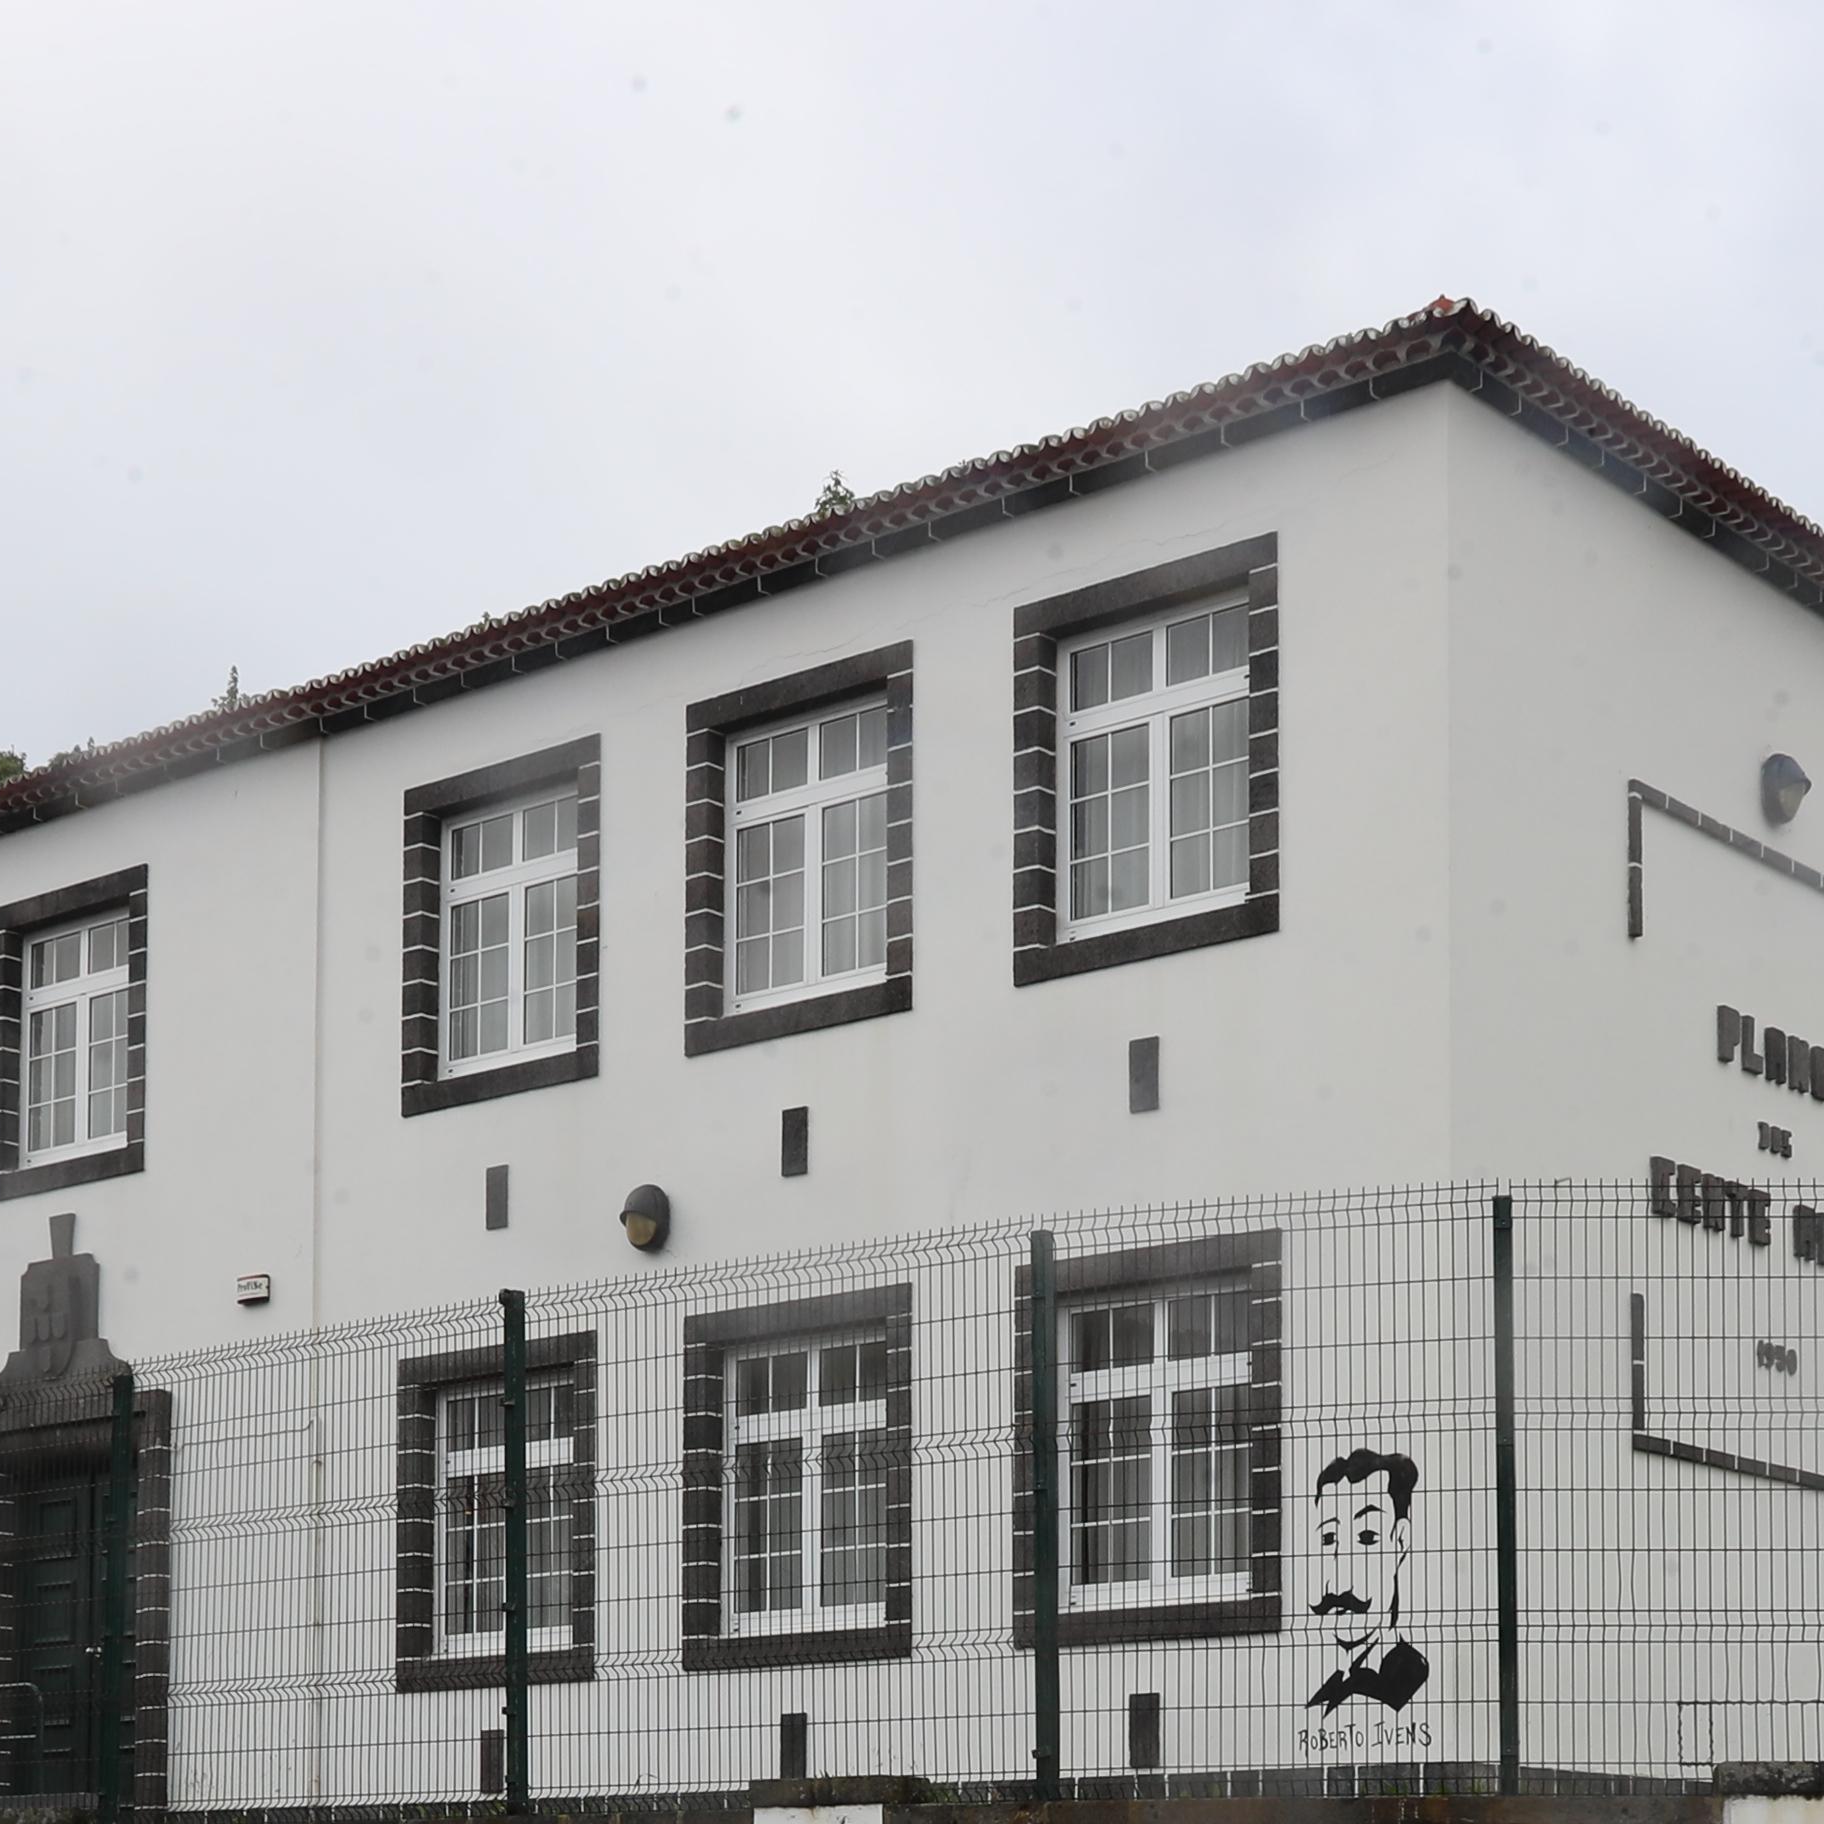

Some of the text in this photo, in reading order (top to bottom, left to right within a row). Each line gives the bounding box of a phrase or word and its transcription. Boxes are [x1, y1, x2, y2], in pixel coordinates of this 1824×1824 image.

[1758, 1121, 1793, 1159] DOS
[1297, 1721, 1433, 1756] ROBERTO IVENS
